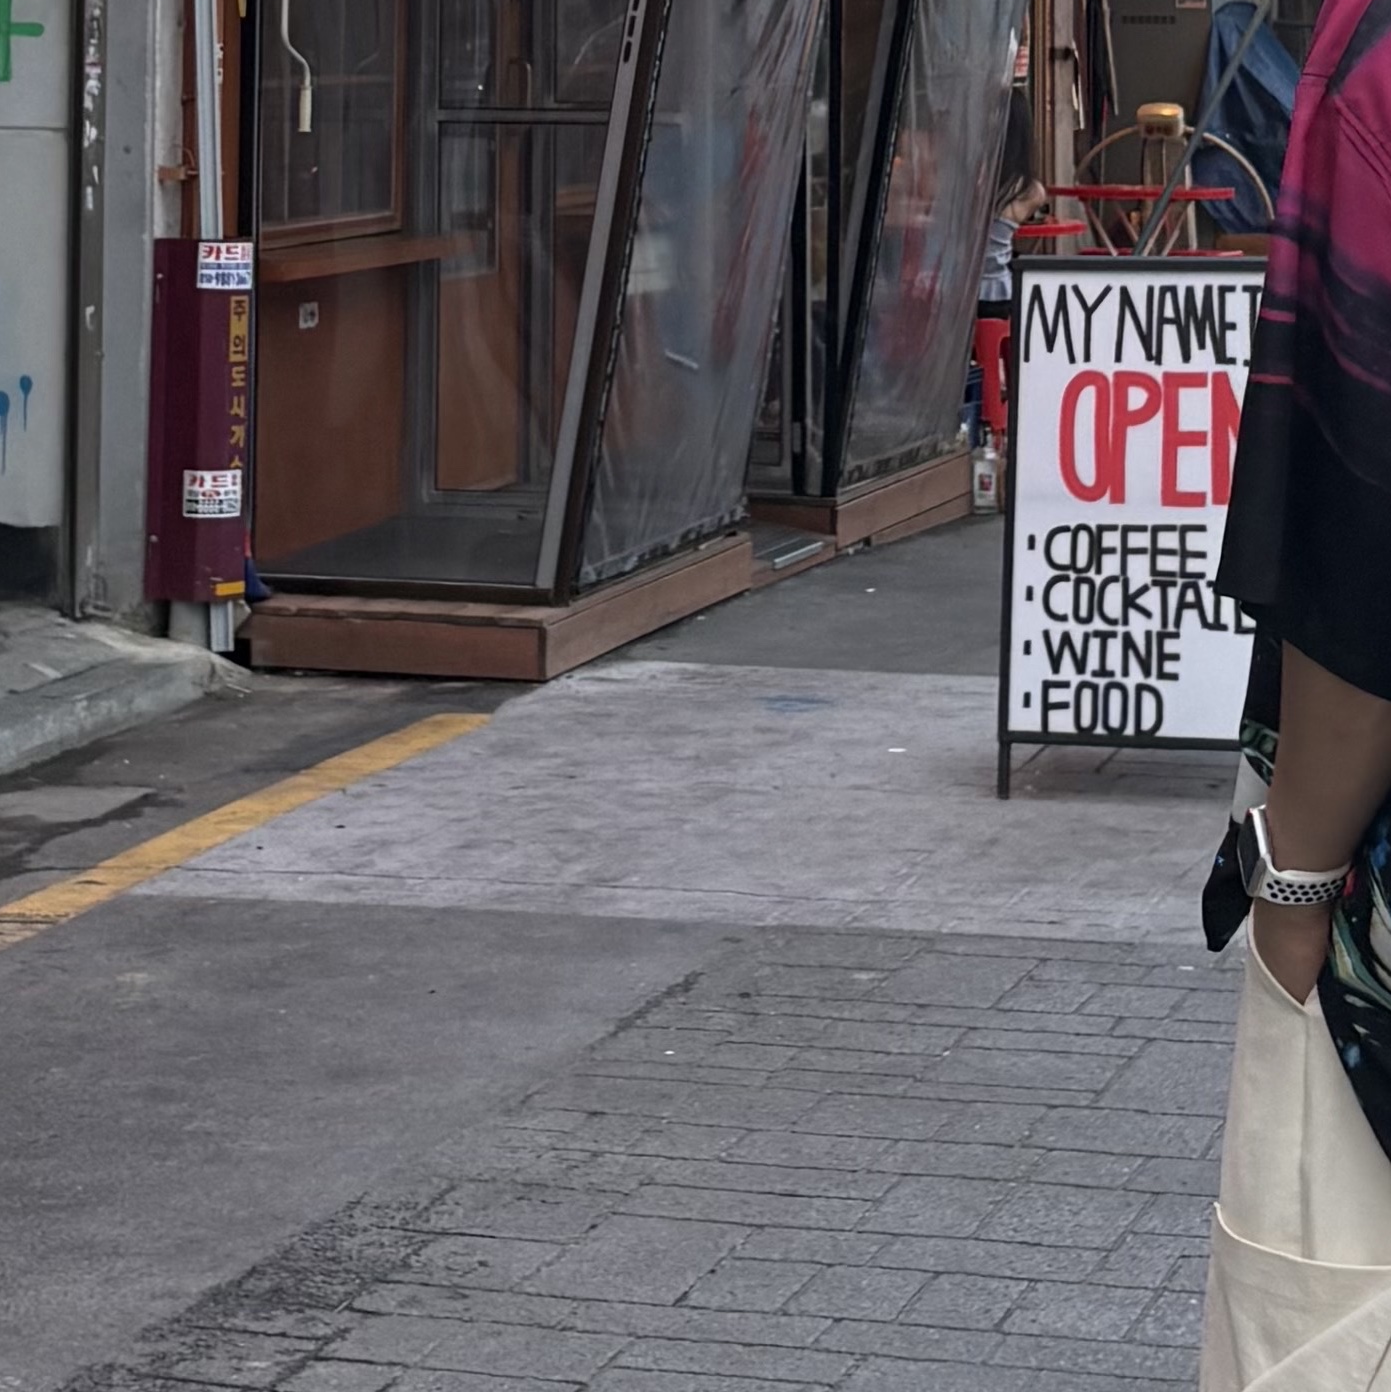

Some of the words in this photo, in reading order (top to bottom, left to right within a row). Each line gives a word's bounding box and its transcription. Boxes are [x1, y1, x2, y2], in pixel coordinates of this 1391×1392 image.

[202, 245, 239, 261] 카드
[232, 299, 246, 356] 주의
[1023, 284, 1112, 364] MY
[1114, 284, 1237, 366] NAME
[188, 474, 229, 488] 카드
[1044, 523, 1207, 580] COFFEE
[1042, 629, 1181, 681] WINE
[1040, 680, 1164, 737] FOOD
